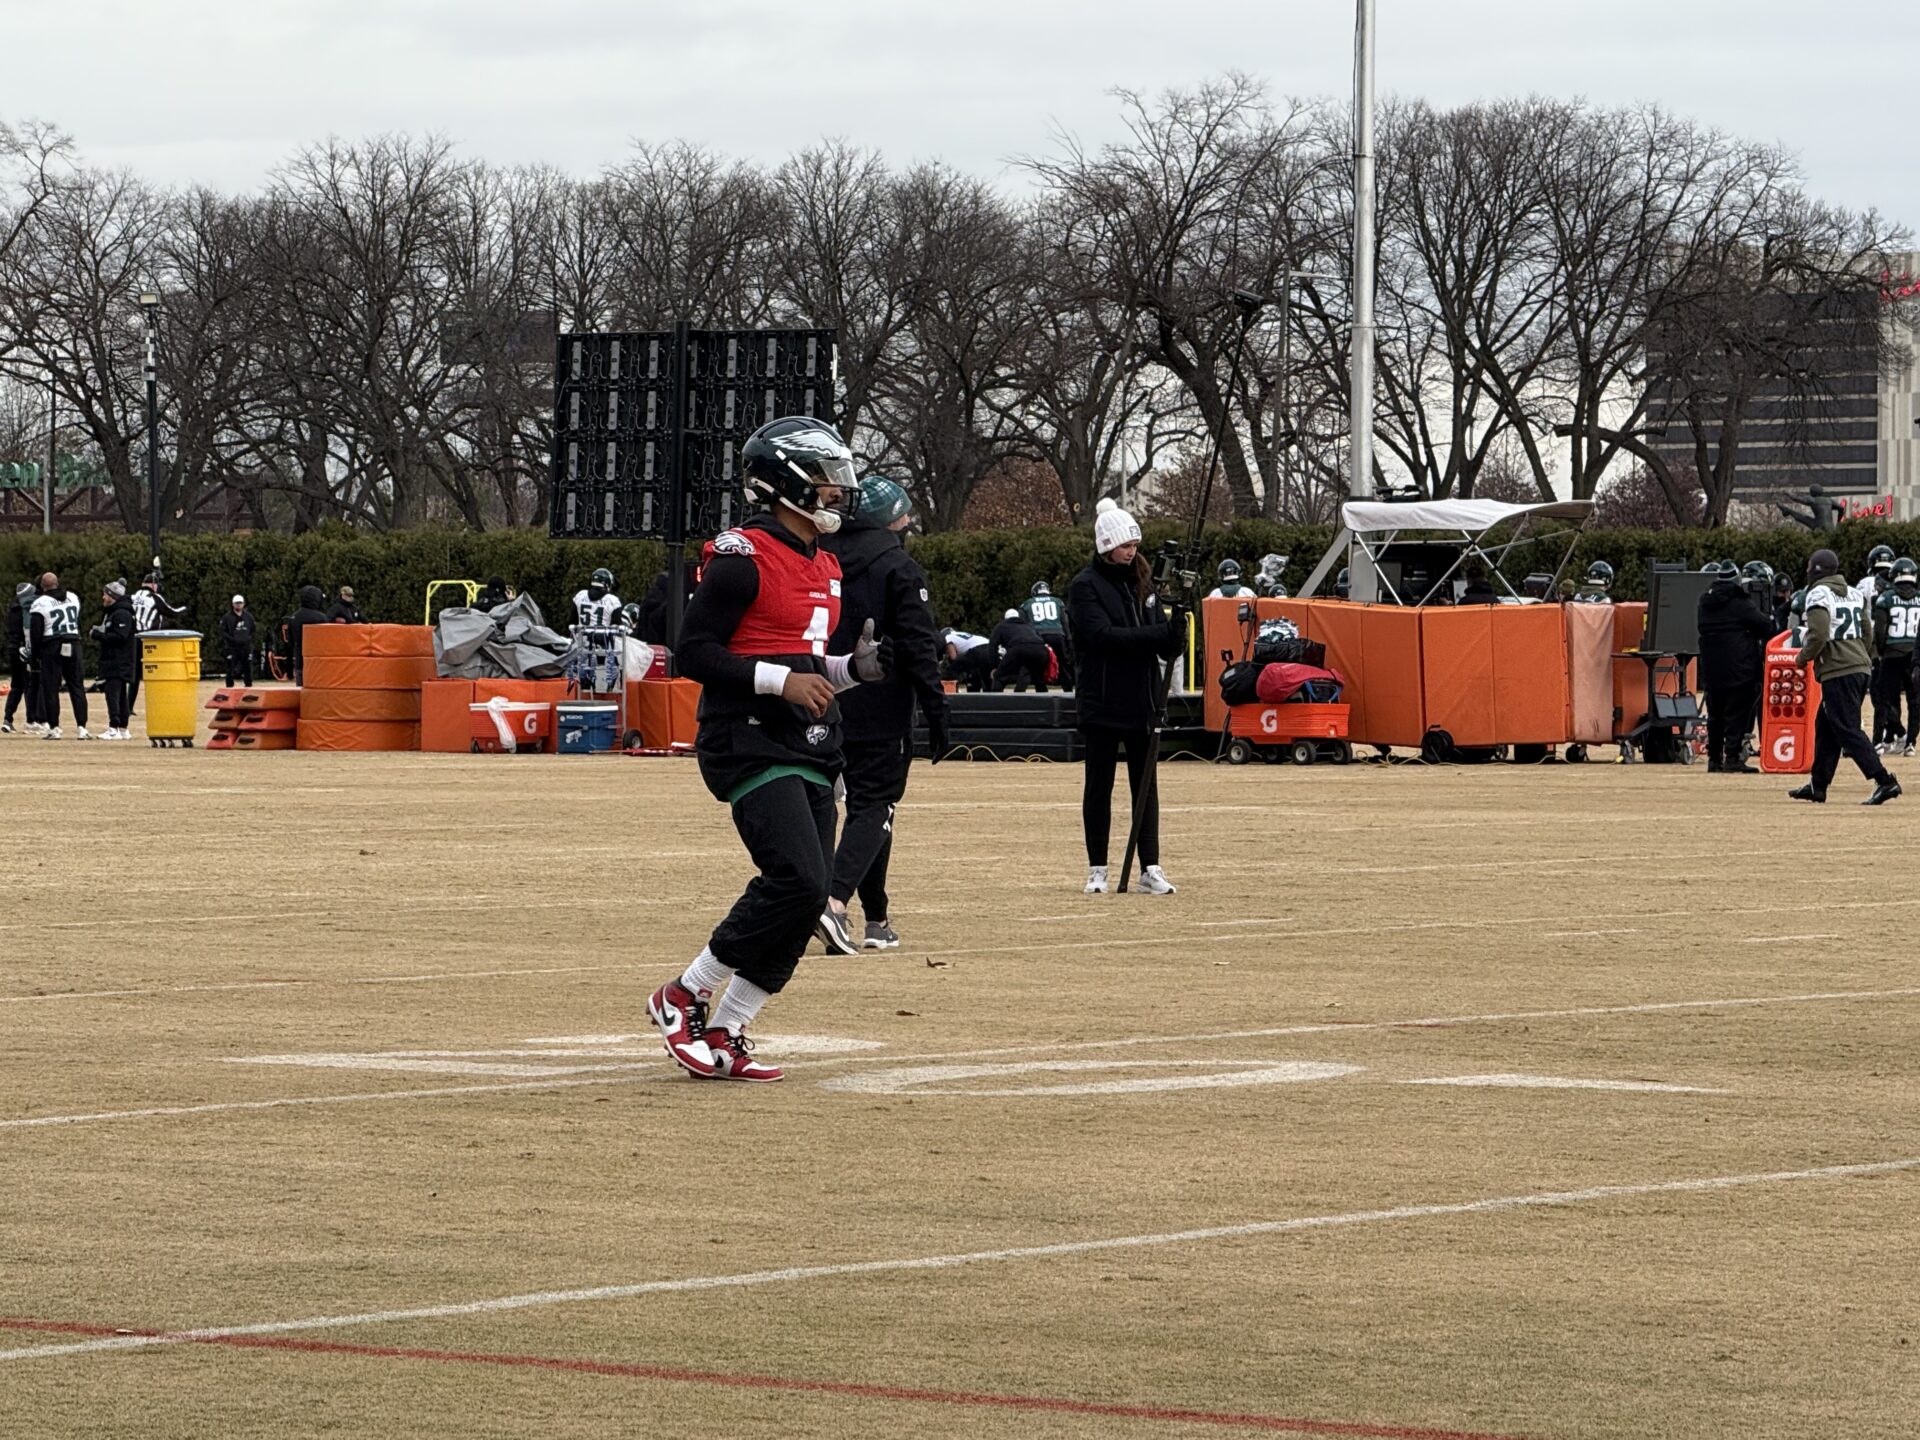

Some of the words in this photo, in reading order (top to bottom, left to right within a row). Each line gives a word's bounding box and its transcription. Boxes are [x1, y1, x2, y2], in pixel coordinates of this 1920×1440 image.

[50, 606, 78, 634] 29
[580, 604, 605, 626] 51
[1031, 602, 1057, 621] 90
[1888, 607, 1920, 638] 38
[802, 607, 829, 657] 1
[524, 713, 537, 734] G
[1261, 710, 1278, 733] G
[1773, 736, 1795, 762] G
